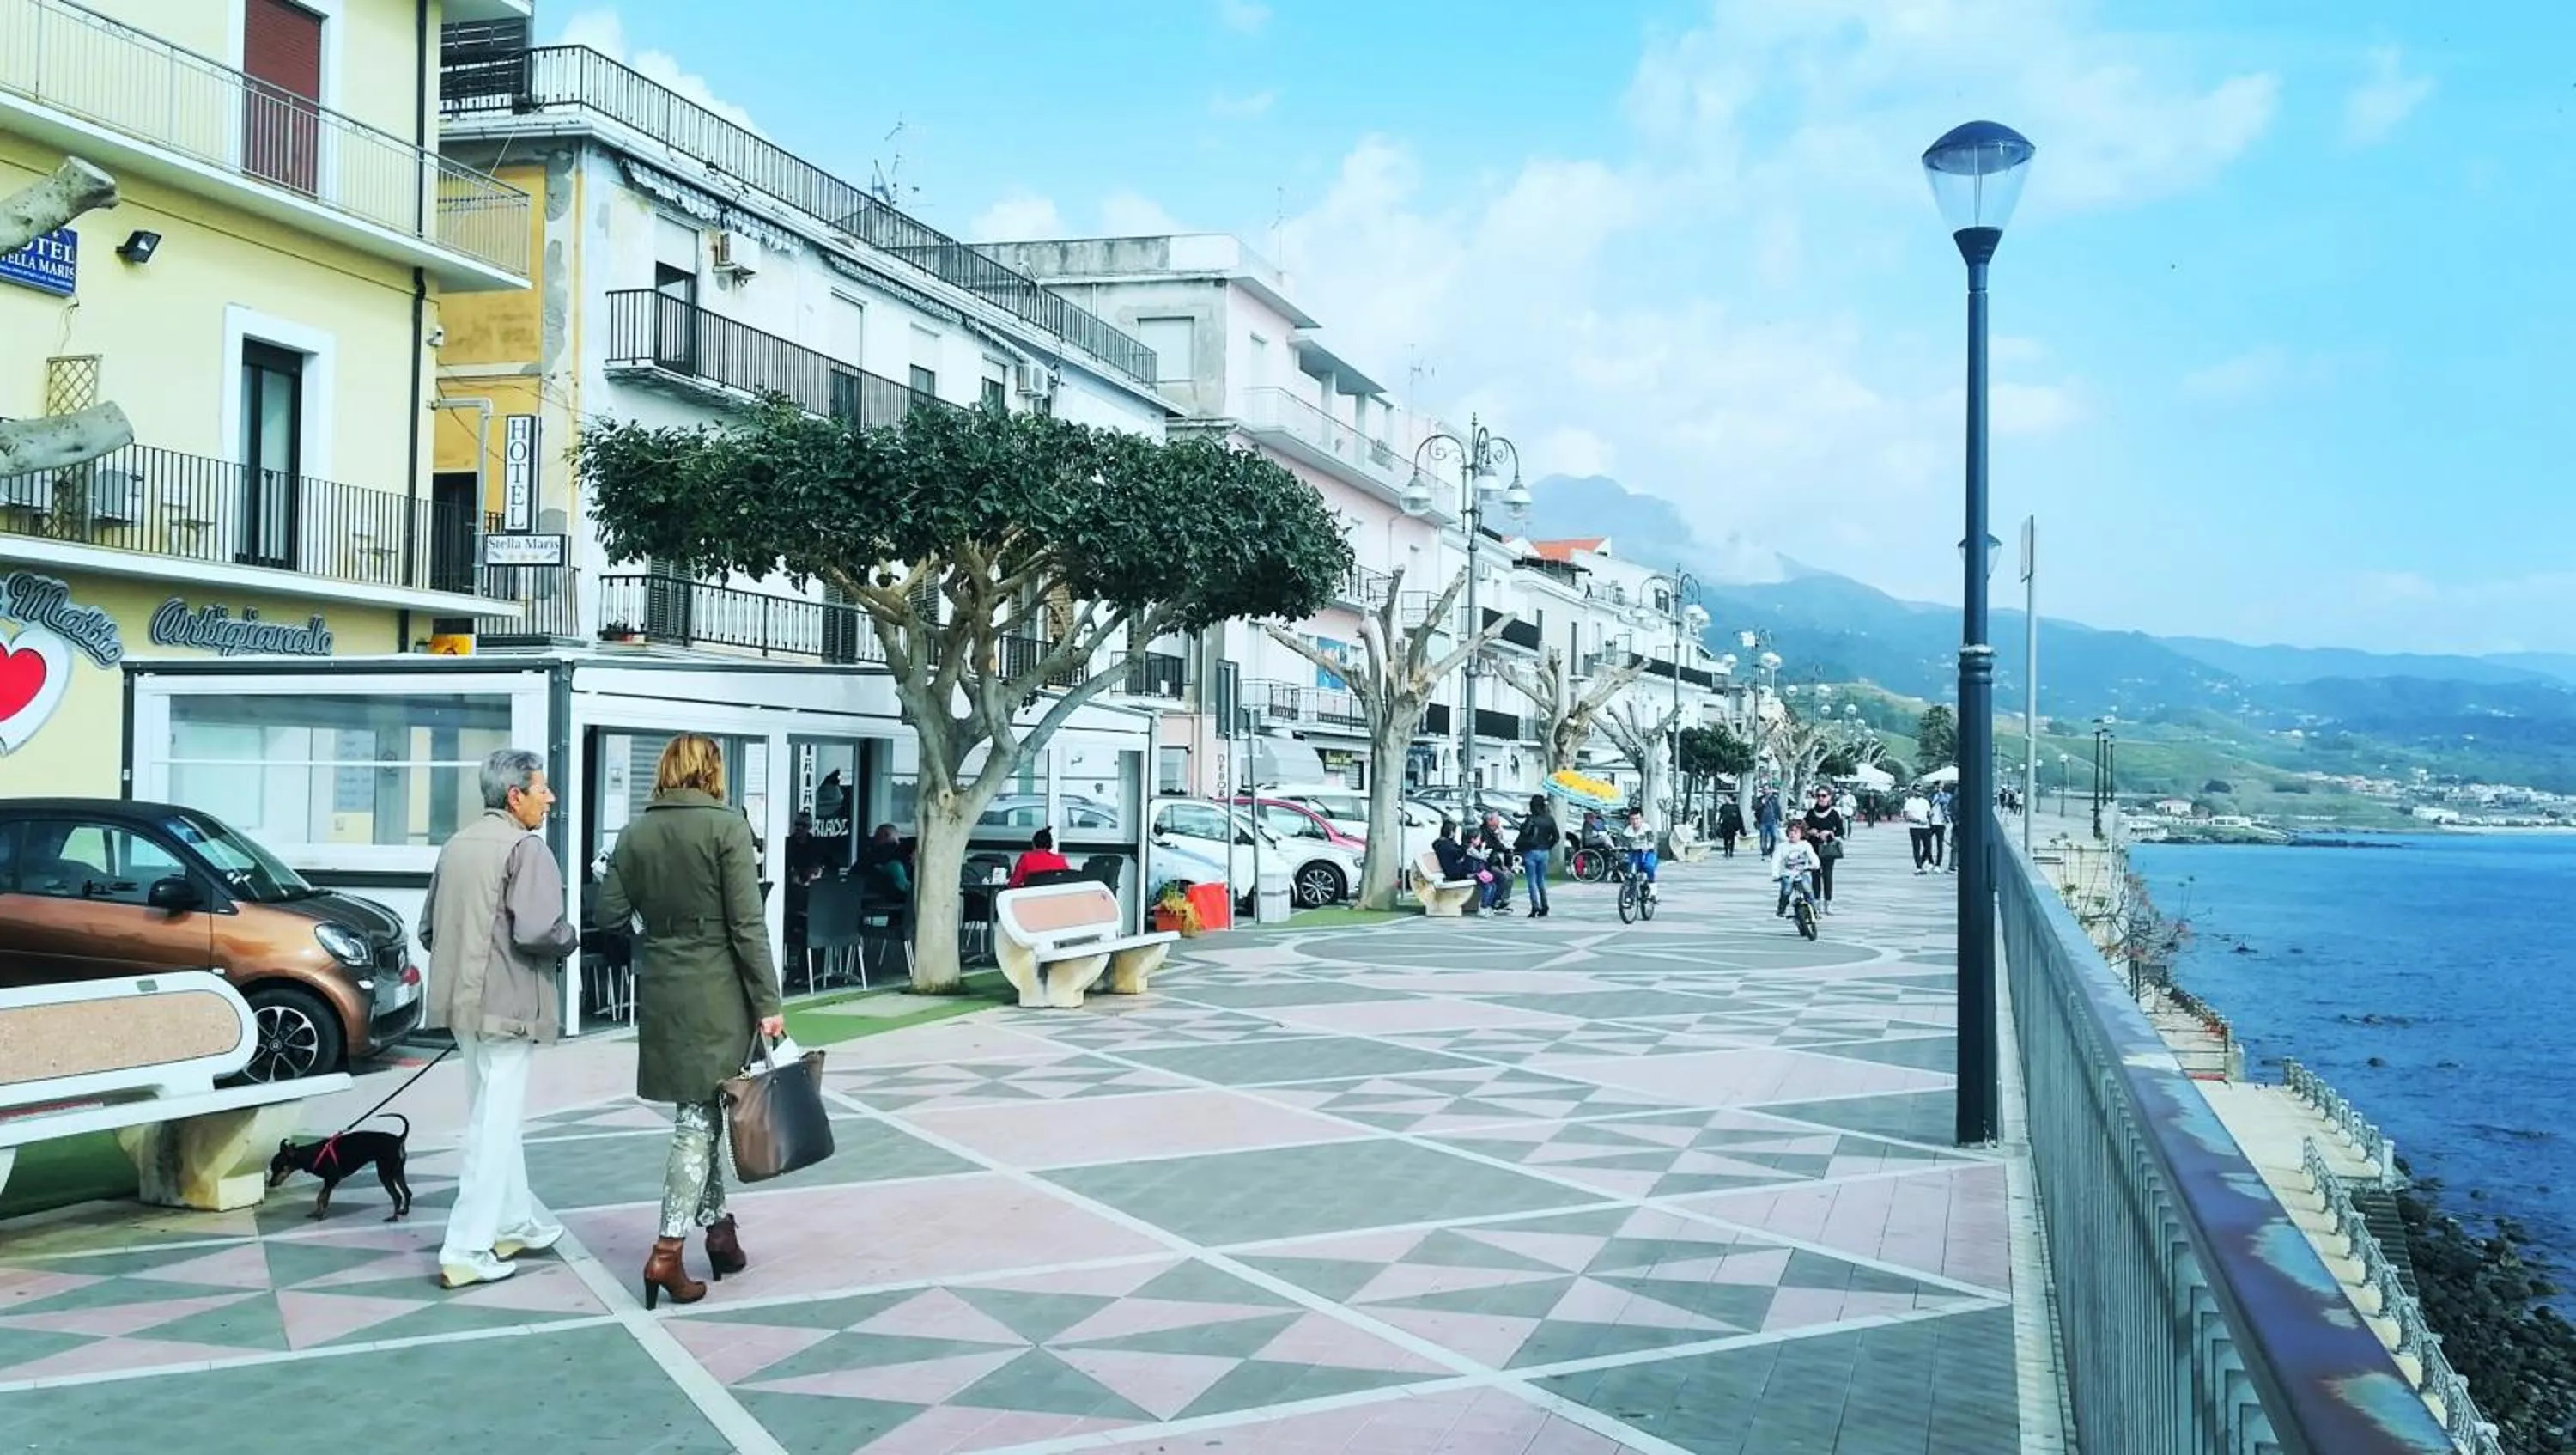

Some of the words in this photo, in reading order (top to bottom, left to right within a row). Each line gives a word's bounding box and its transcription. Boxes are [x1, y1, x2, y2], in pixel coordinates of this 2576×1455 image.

[1, 253, 36, 271] ELLA
[39, 259, 75, 281] MARIS
[21, 236, 75, 264] TEL
[509, 419, 527, 527] HOTEL
[489, 538, 521, 550] Stella
[525, 538, 559, 550] Maris
[7, 573, 123, 666] Matto
[150, 599, 333, 656] Artigianale
